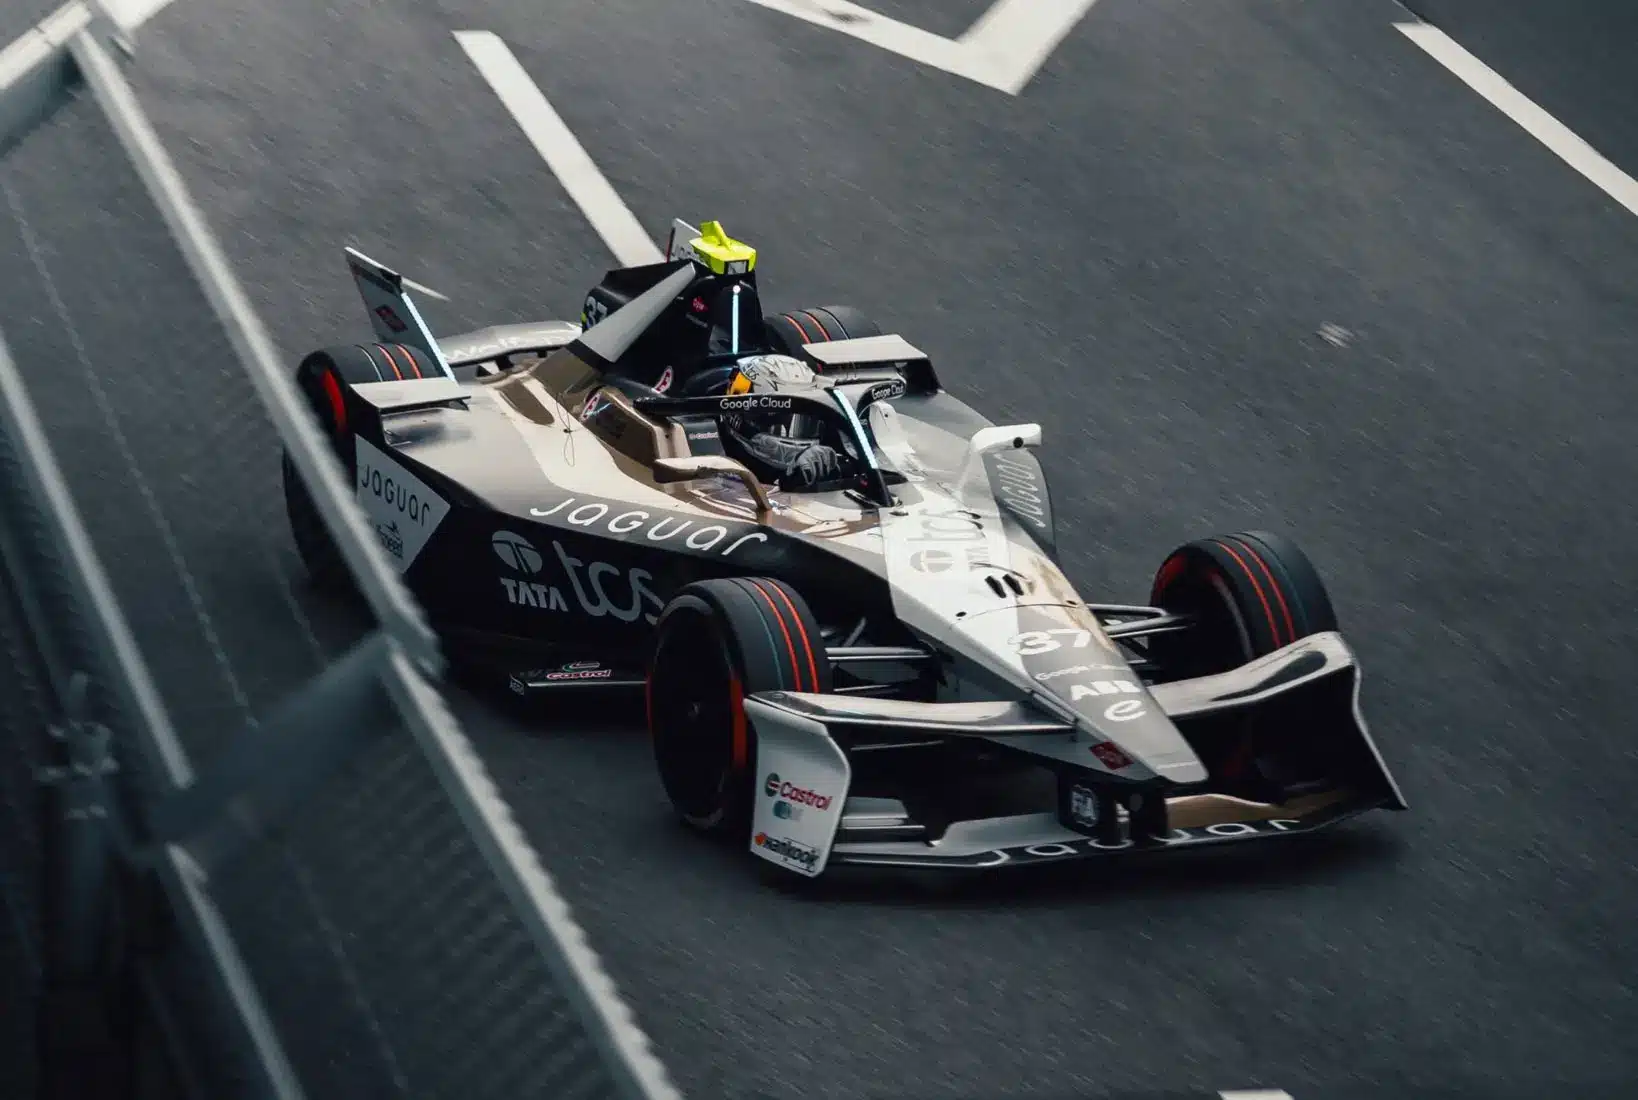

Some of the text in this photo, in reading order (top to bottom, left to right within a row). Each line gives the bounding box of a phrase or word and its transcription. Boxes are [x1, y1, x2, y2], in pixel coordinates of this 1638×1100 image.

[719, 397, 792, 410] Google Cloud
[500, 576, 569, 613] TATA
[552, 539, 665, 625] tcs
[1007, 628, 1092, 656] 37
[546, 669, 612, 680] Castrol
[780, 781, 833, 811] Castrol
